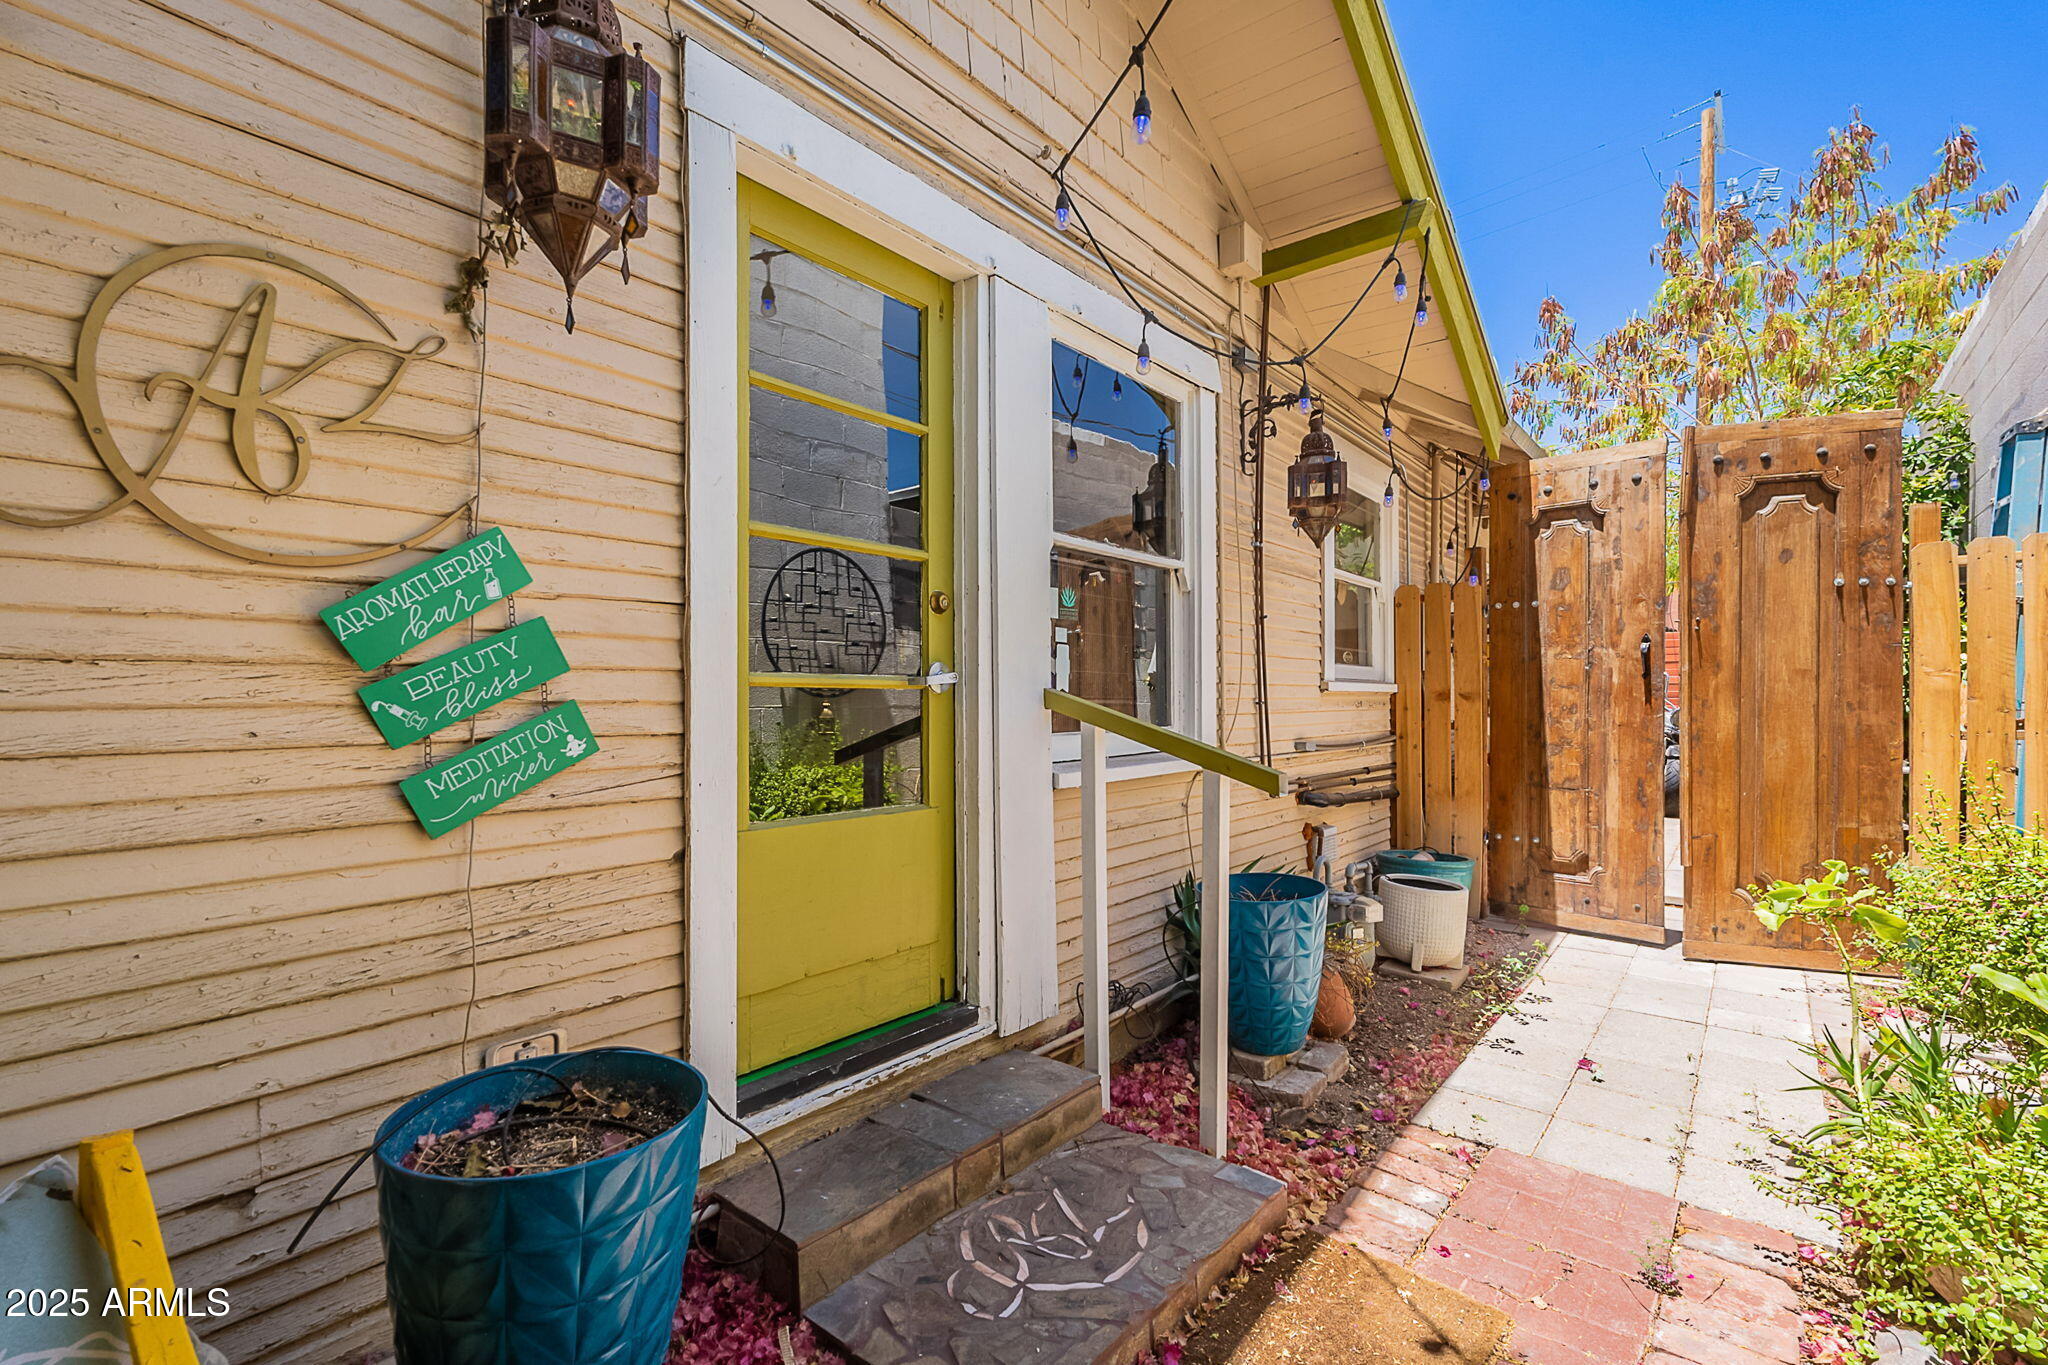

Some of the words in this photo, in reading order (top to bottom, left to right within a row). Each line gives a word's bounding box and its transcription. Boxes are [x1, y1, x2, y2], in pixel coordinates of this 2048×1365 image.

[334, 535, 507, 641] AROMATHERAPY
[401, 589, 481, 645] bar
[402, 636, 519, 701] BEAUTY
[435, 666, 532, 720] bliss
[424, 714, 569, 799] MEDITATION
[430, 752, 557, 822] mixer
